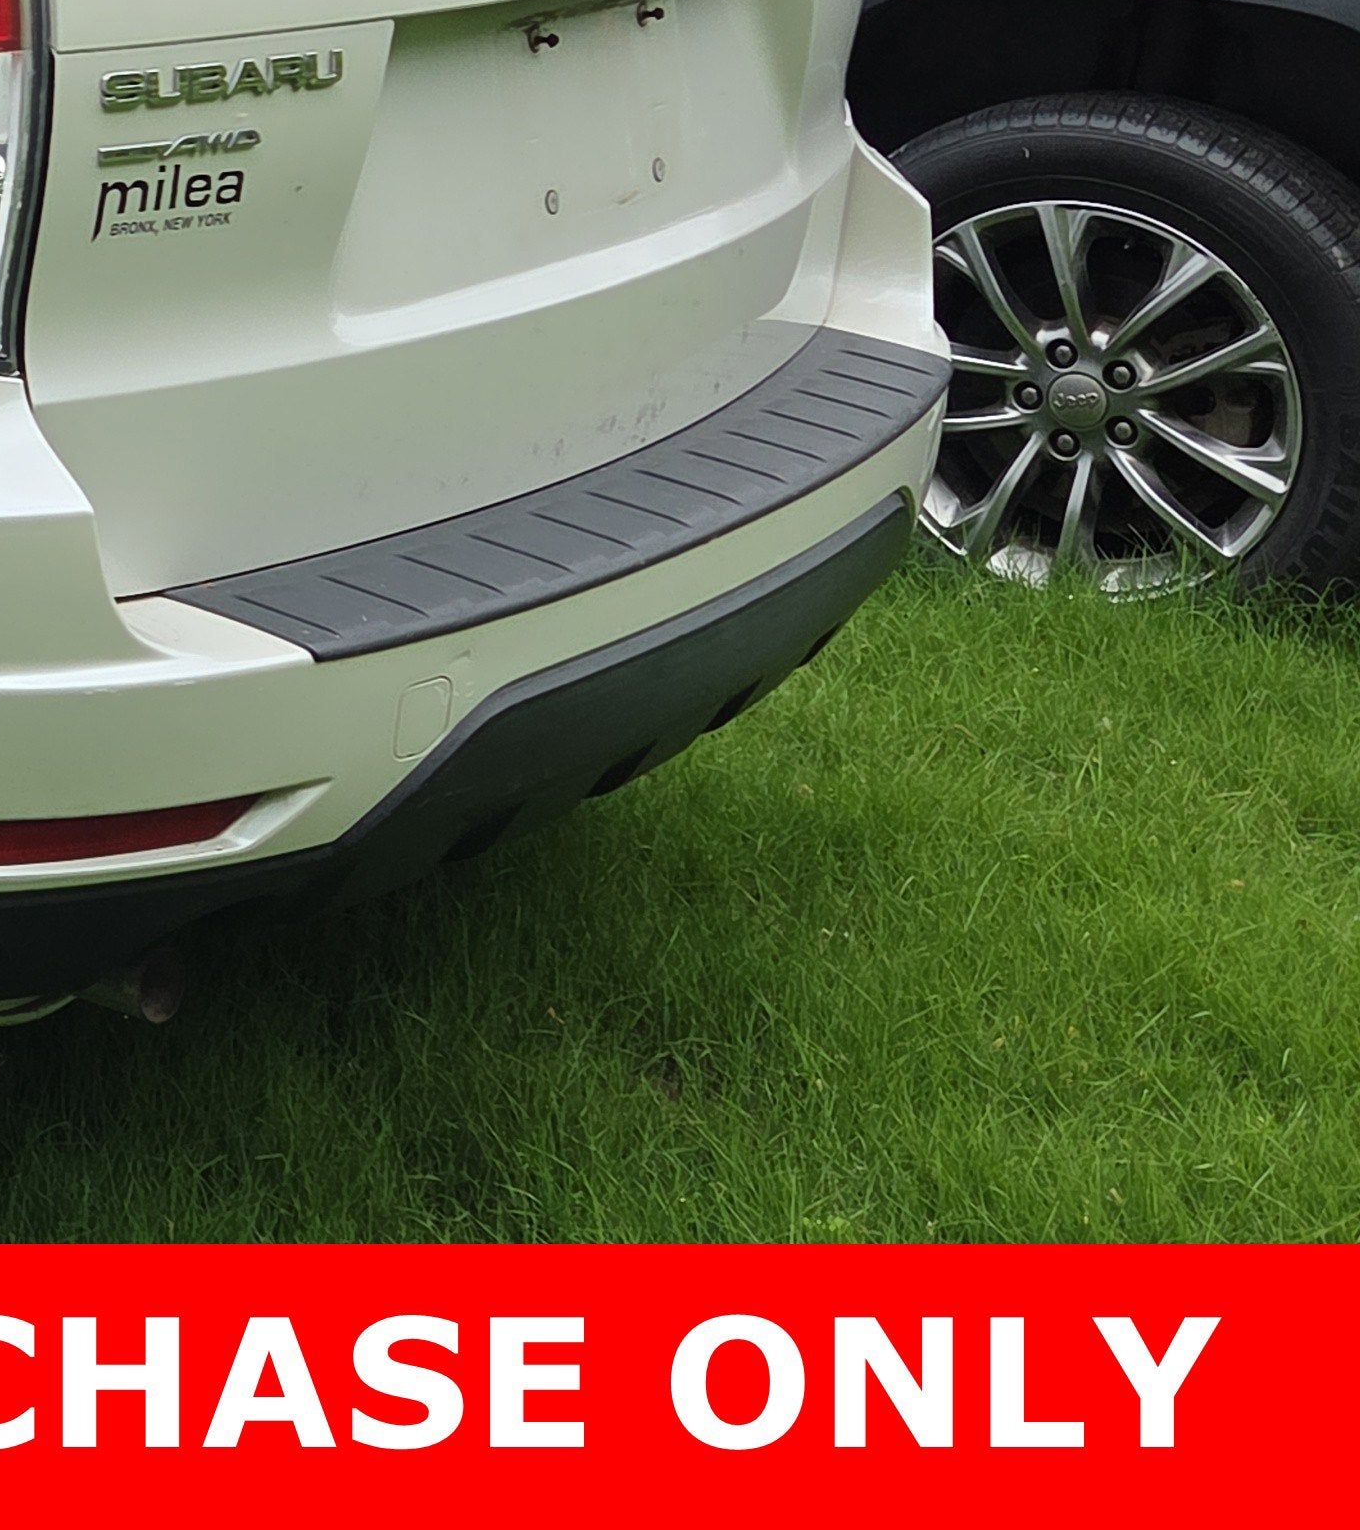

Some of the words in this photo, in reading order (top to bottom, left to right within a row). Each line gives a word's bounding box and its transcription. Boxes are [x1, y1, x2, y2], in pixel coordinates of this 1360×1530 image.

[99, 49, 344, 113] SUBARU
[92, 164, 244, 243] milea
[109, 220, 160, 237] BRONX,
[162, 215, 195, 231] NEW
[197, 211, 233, 228] YORK
[1053, 392, 1099, 409] Jeep
